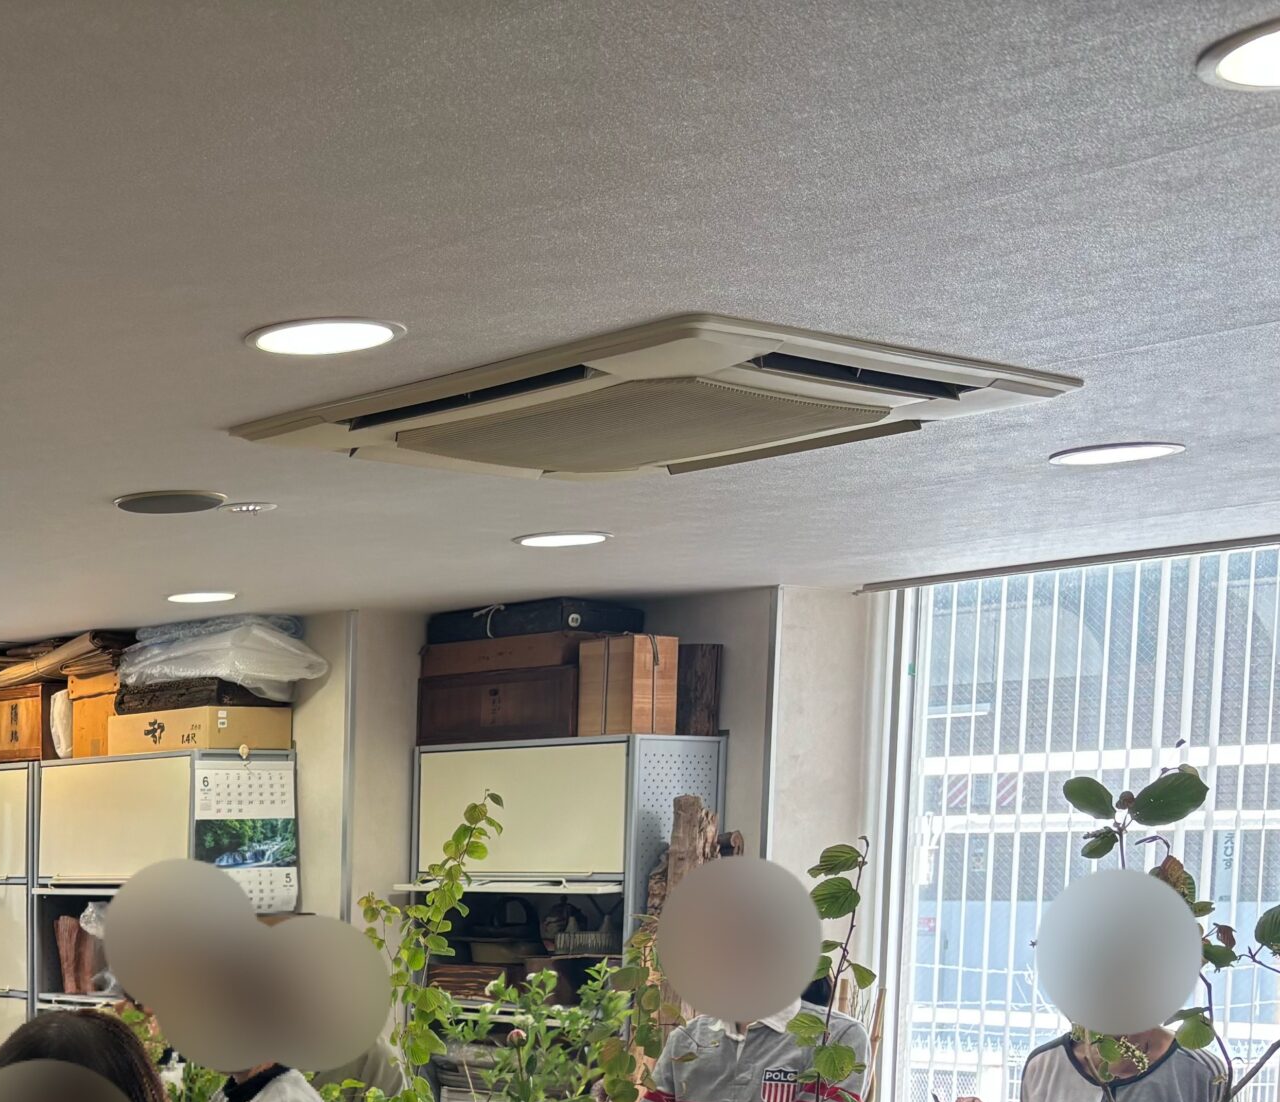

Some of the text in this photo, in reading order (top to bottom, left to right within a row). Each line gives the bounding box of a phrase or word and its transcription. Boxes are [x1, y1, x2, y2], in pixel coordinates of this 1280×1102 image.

[202, 776, 209, 788] 6
[285, 872, 292, 883] 5
[765, 1071, 796, 1081] POLO
